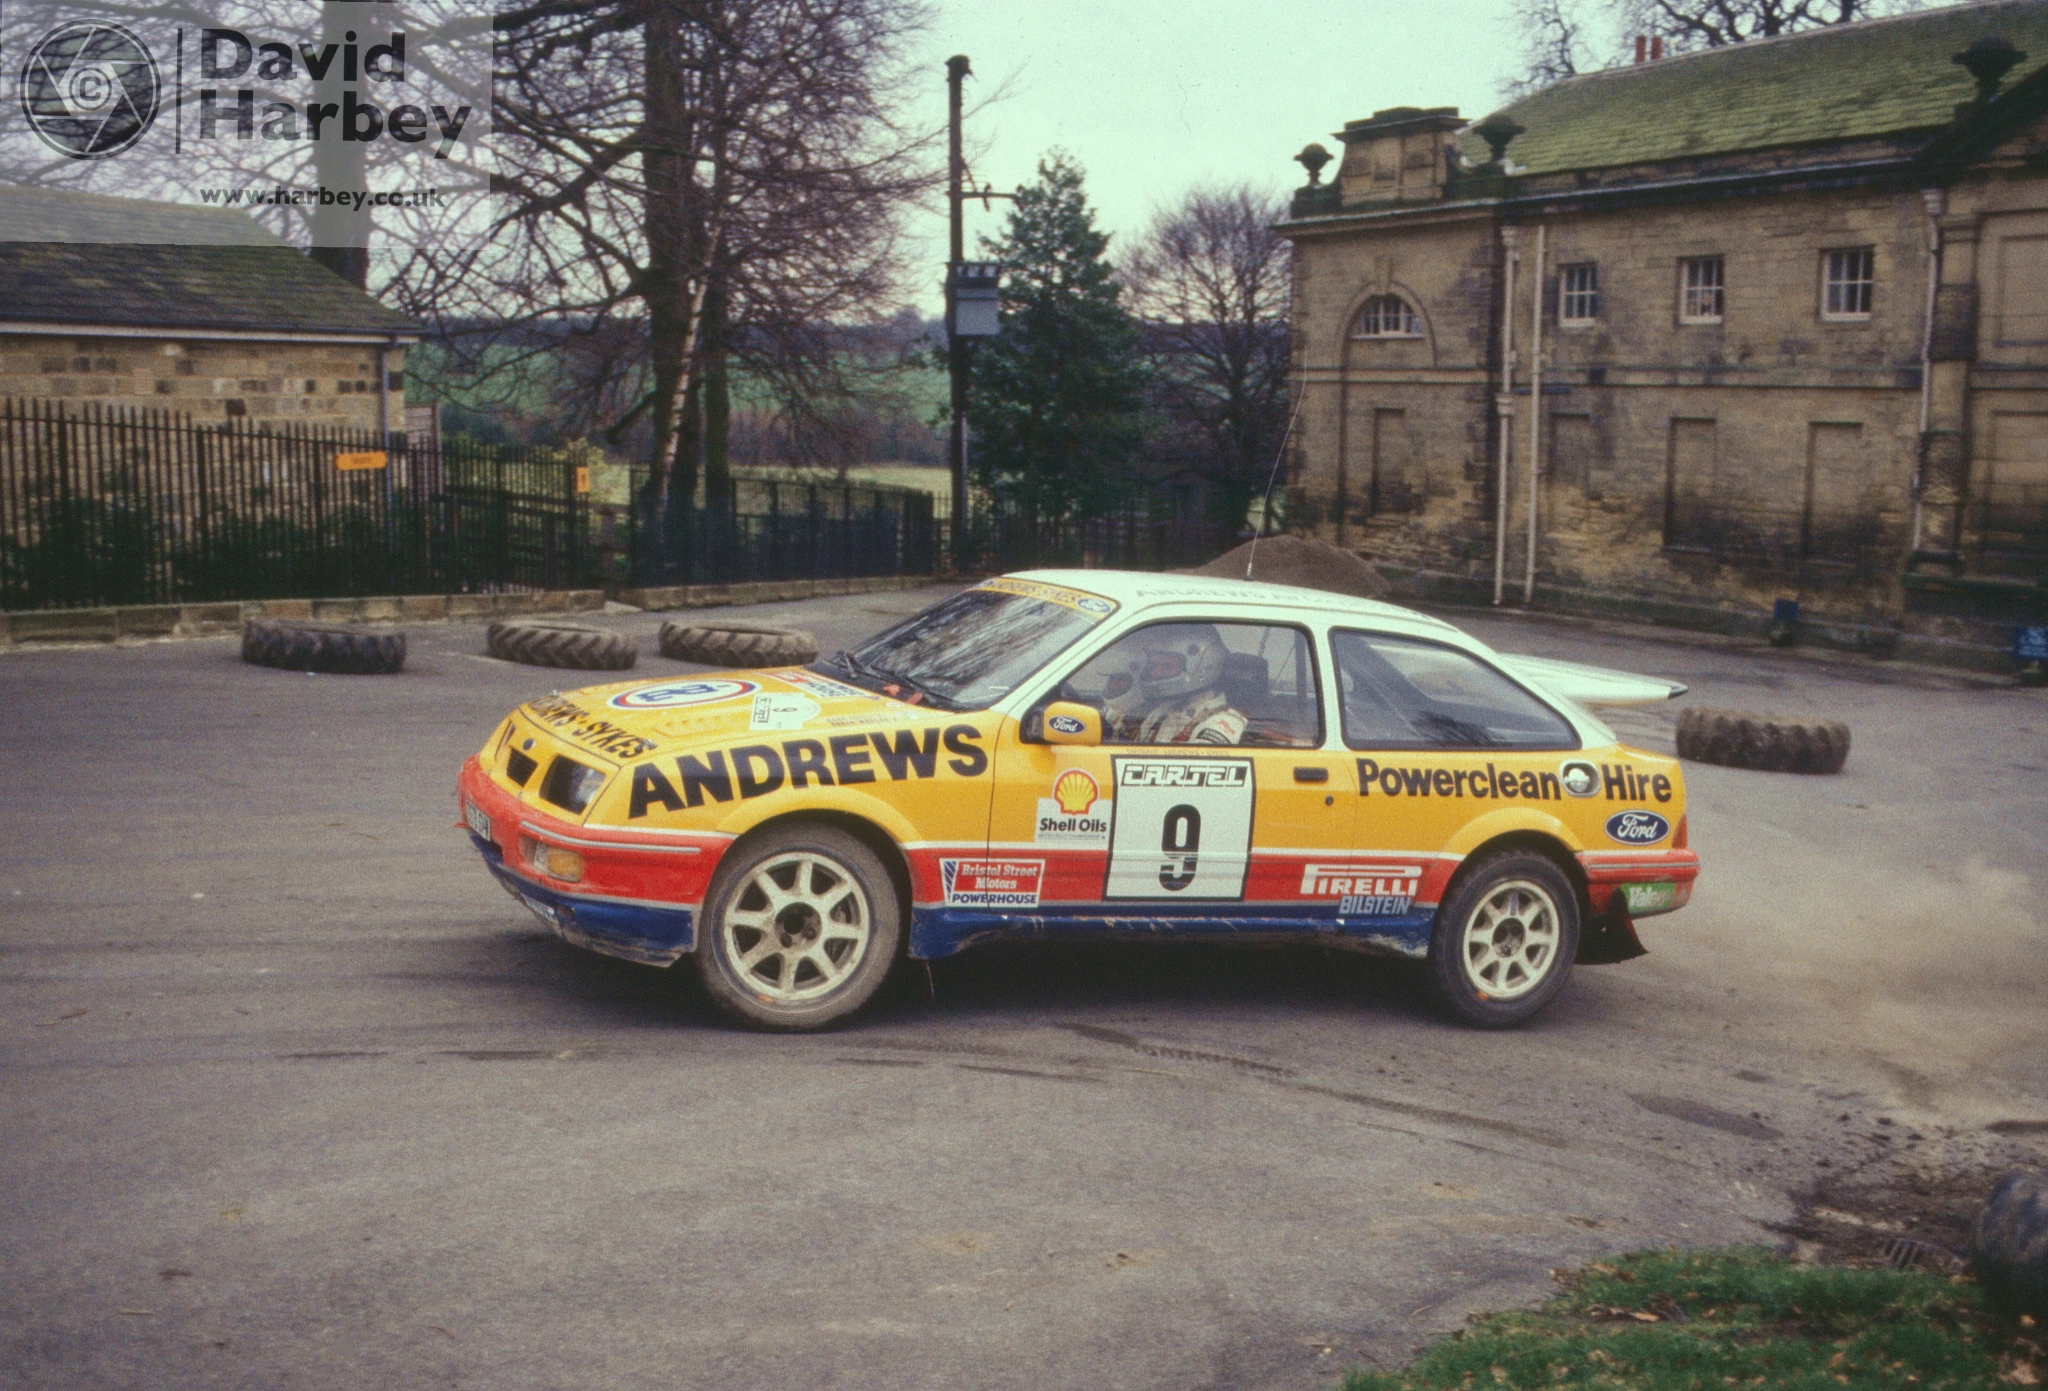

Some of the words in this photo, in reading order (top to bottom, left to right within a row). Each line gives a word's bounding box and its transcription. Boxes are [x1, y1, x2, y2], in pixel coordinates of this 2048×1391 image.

[1053, 716, 1078, 733] Ford
[628, 724, 988, 819] ANDREWS
[1121, 764, 1248, 787] CARTEL
[1356, 758, 1561, 800] Powerclean
[1602, 764, 1671, 802] Hire
[1040, 818, 1076, 832] Shell
[1079, 819, 1107, 833] Oils
[1617, 813, 1659, 839] Ford
[1159, 804, 1201, 891] 9
[962, 864, 1001, 876] Bristol
[1003, 864, 1038, 877] Street
[1300, 864, 1423, 896] PIRELLI
[975, 877, 1017, 890] Motors
[952, 894, 1037, 904] POWERHOUSE
[1339, 896, 1411, 915] BILSTEIN
